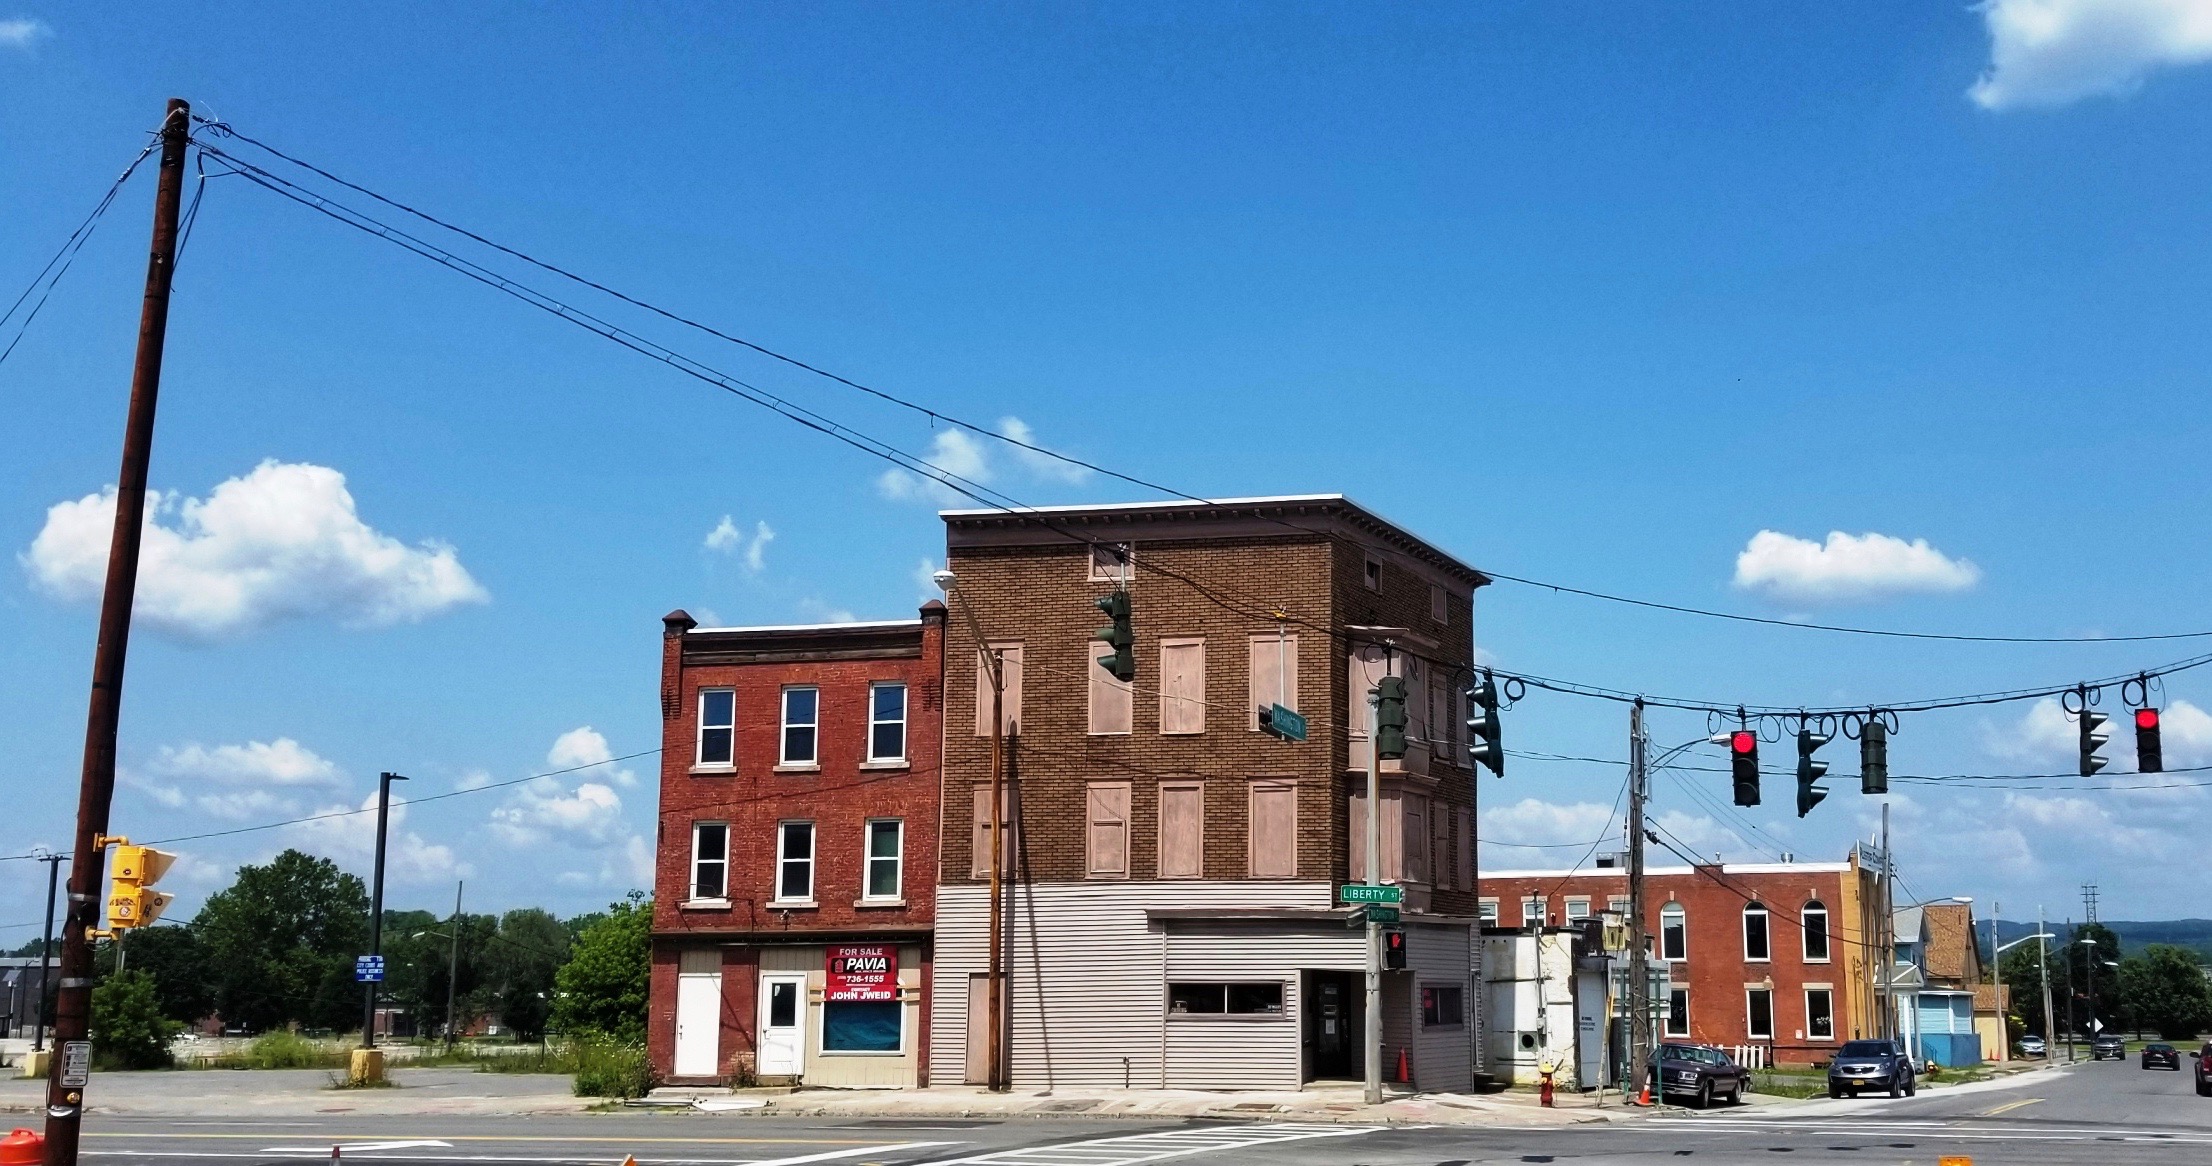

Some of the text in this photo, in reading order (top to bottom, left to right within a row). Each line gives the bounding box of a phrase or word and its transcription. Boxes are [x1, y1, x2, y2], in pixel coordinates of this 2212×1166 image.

[1343, 889, 1385, 899] LIBERTY
[839, 948, 882, 956] FOR SALE
[846, 957, 886, 970] PAVIA
[831, 991, 891, 1000] JOHN JWEID
